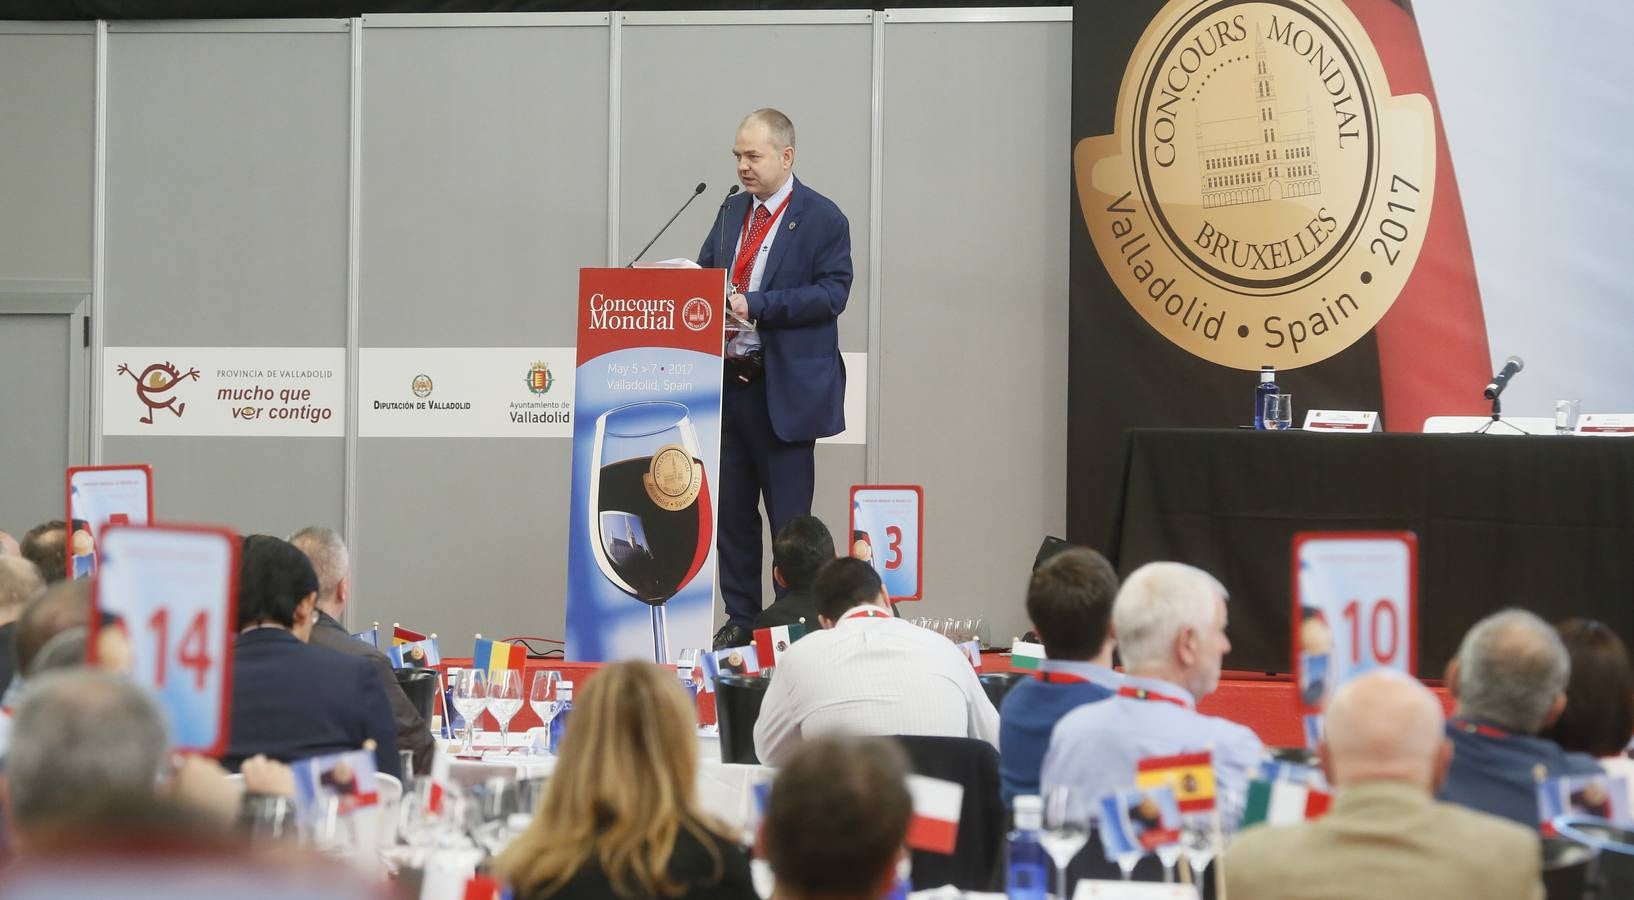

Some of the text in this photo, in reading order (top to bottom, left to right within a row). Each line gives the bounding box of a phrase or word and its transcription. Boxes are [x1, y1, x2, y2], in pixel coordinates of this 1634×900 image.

[1153, 14, 1360, 168] CONCOURS MONDIAL
[1193, 207, 1337, 271] BRUXELLES
[1105, 174, 1420, 354] Valladolid Spain 2017
[589, 293, 675, 312] Concours
[588, 308, 675, 330] Mondial
[216, 370, 333, 379] PROVINCIA DE VALLADOLID
[607, 363, 629, 376] May
[632, 363, 639, 374] 5
[651, 363, 658, 374] 7
[668, 363, 694, 375] 2017
[217, 385, 311, 405] mucho que
[607, 380, 693, 393] Valladolid, Spain
[268, 405, 332, 424] contigo
[509, 401, 570, 410] Ayuntamiento de
[509, 411, 570, 424] Valladolid
[884, 524, 904, 570] 3
[1343, 597, 1400, 667] 10
[148, 606, 214, 694] 14
